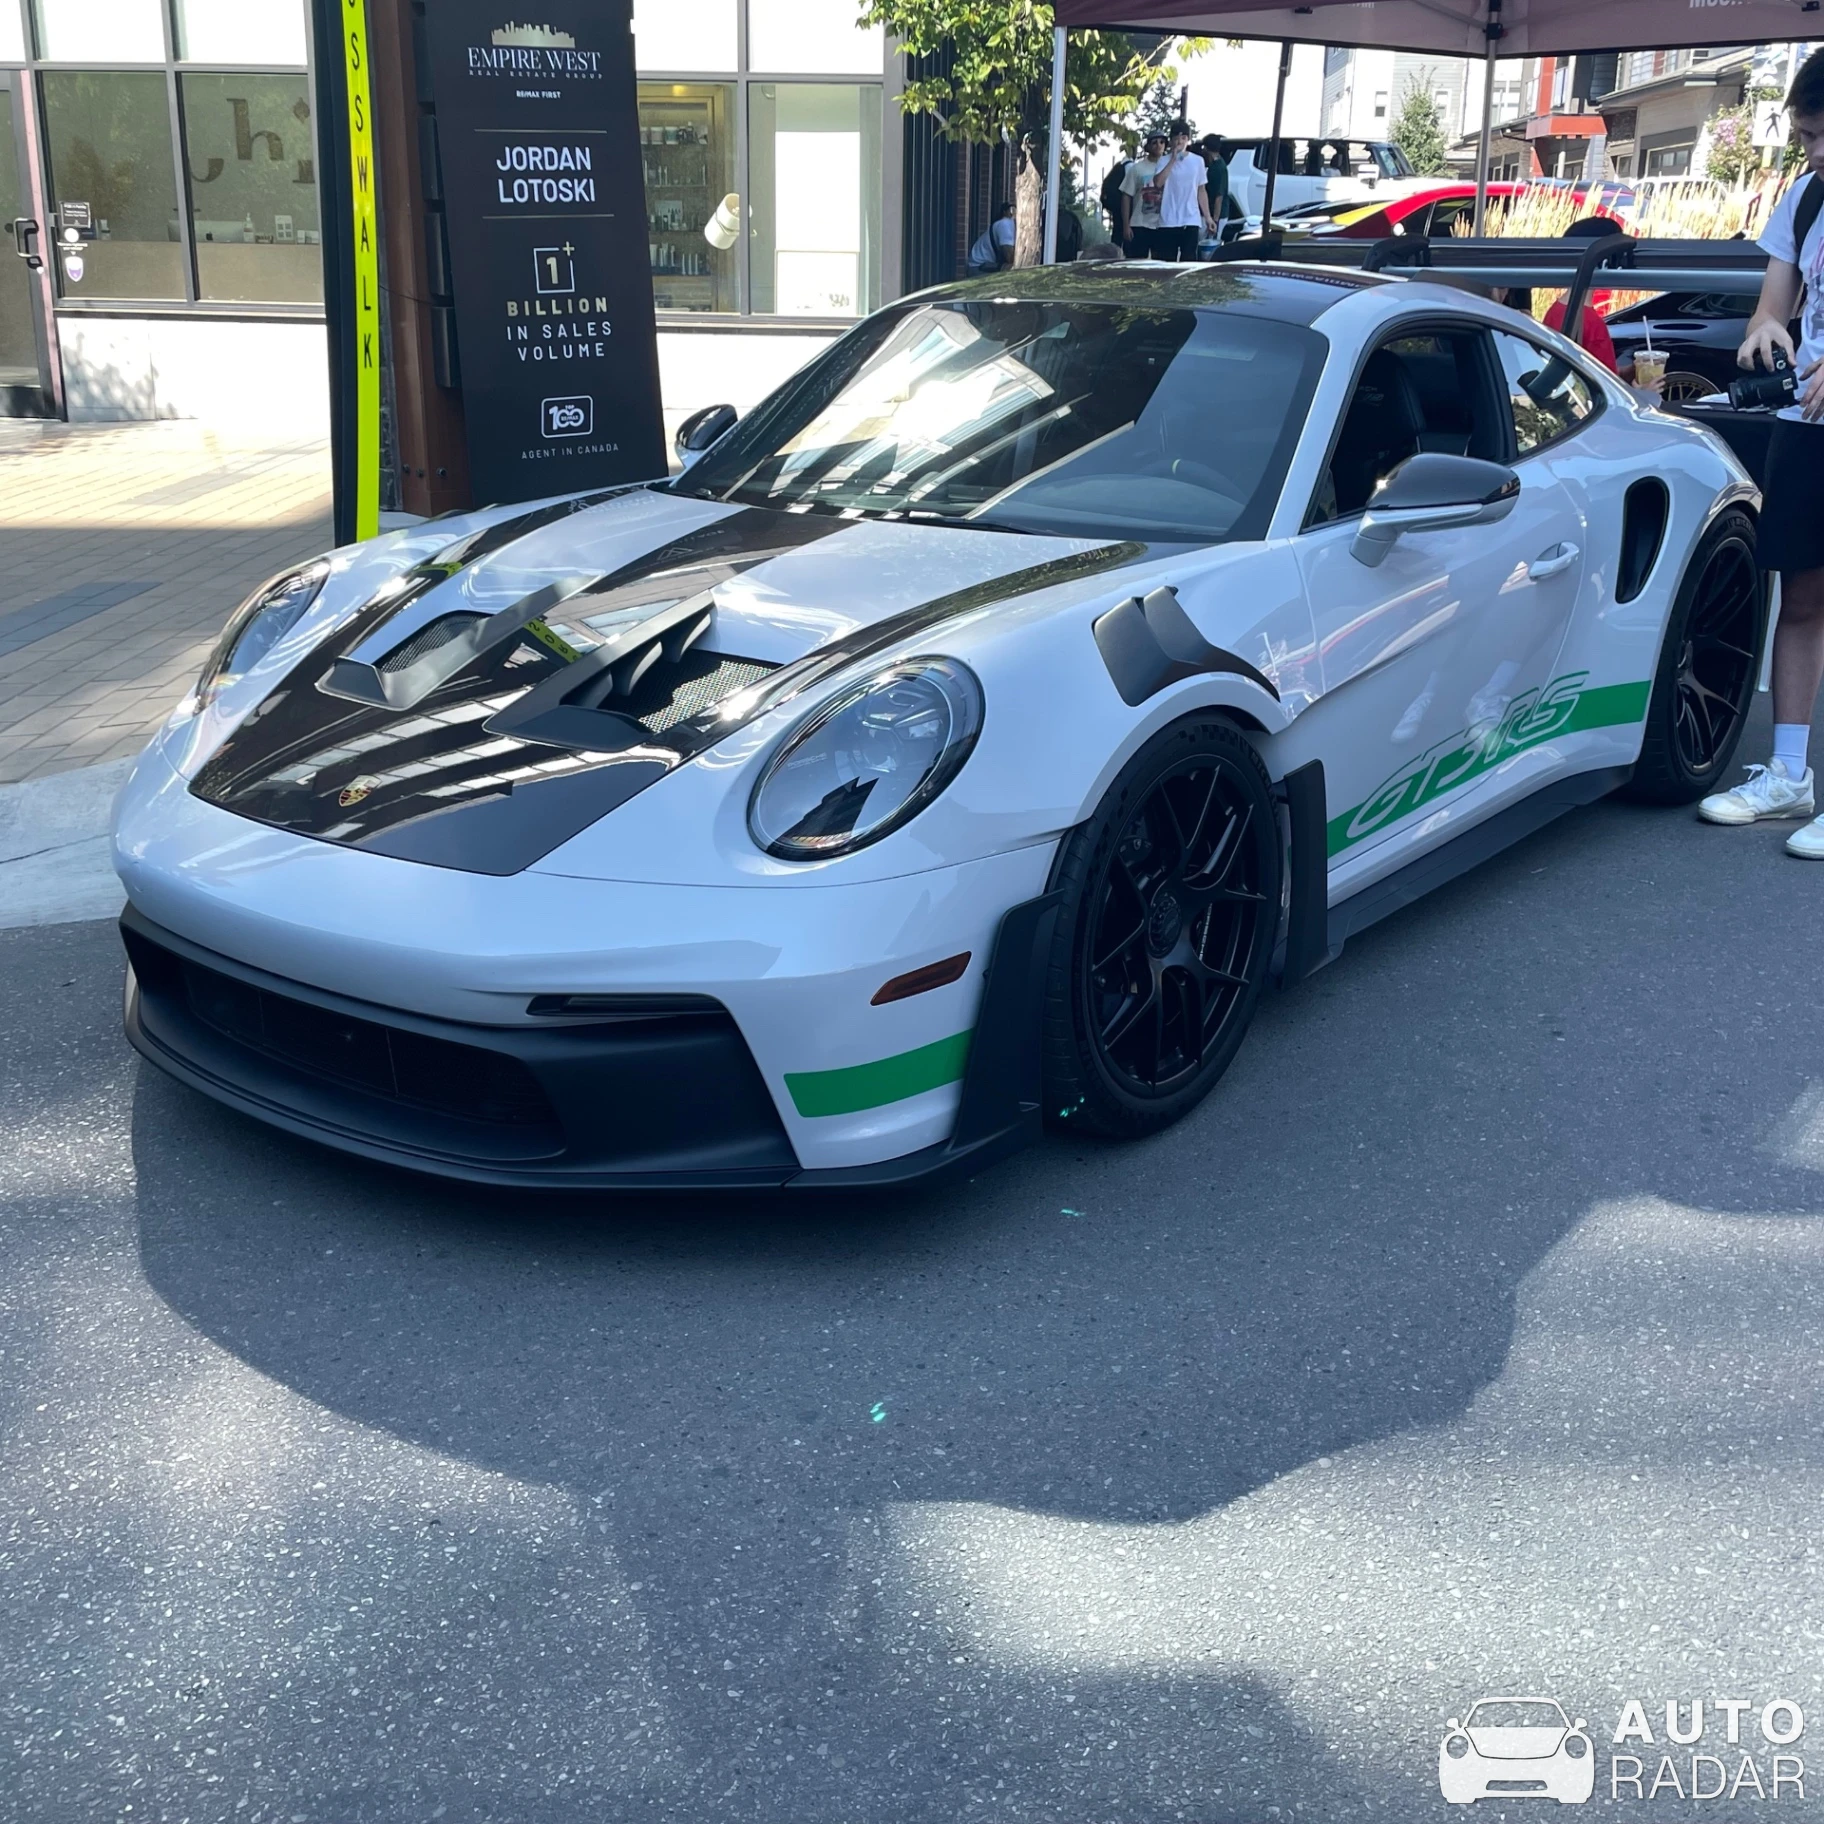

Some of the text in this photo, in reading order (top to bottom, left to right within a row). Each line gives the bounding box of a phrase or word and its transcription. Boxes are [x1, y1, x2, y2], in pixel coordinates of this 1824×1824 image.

[468, 47, 601, 71] EMPIRE WEST
[541, 90, 561, 99] FIRST
[496, 146, 592, 171] JORDAN
[348, 0, 374, 369] SSWALK
[498, 178, 596, 203] LOTOSKI
[506, 296, 608, 317] BILLION
[507, 321, 612, 341] IN SALES
[517, 342, 605, 361] VOLUME
[521, 443, 619, 460] AGENT IN CANADA
